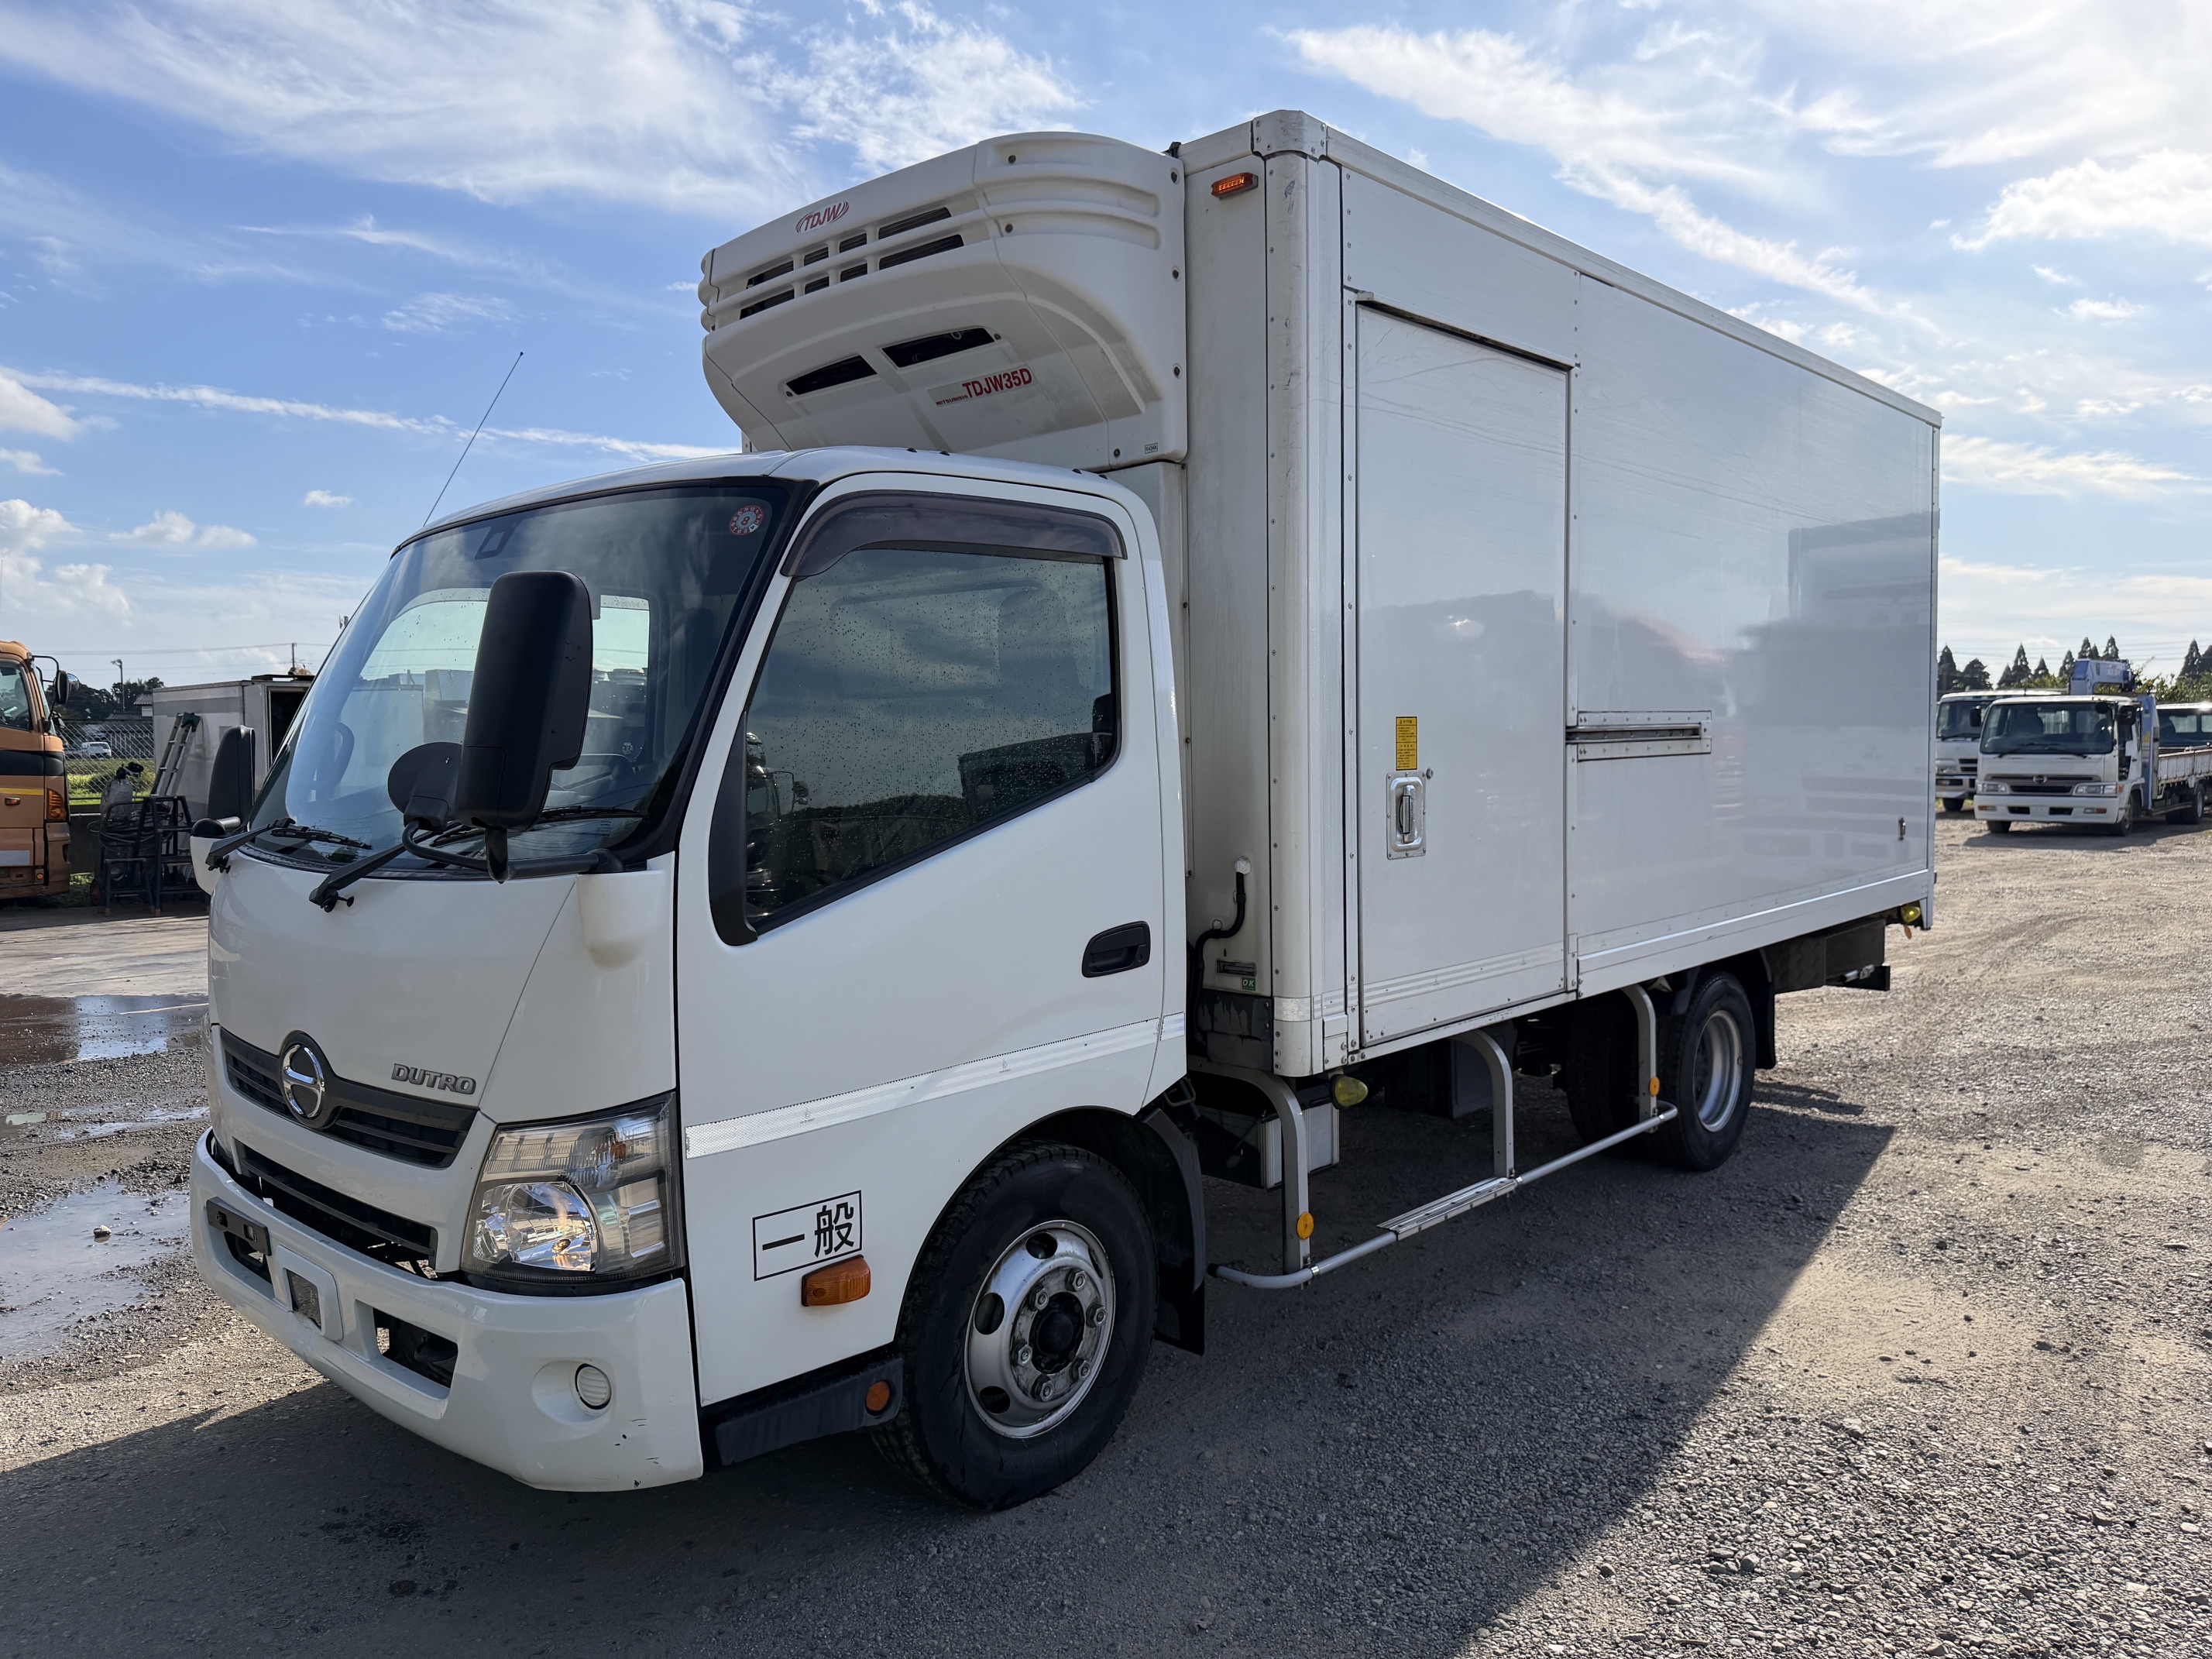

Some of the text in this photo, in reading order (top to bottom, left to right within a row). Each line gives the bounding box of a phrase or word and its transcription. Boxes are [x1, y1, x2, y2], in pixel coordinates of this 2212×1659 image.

[804, 202, 842, 232] TDJW
[936, 368, 1032, 405] MITSUBISHI TDJW35D
[740, 516, 750, 526] 8
[391, 1063, 476, 1095] DUTRO
[762, 1201, 854, 1258] 一般
